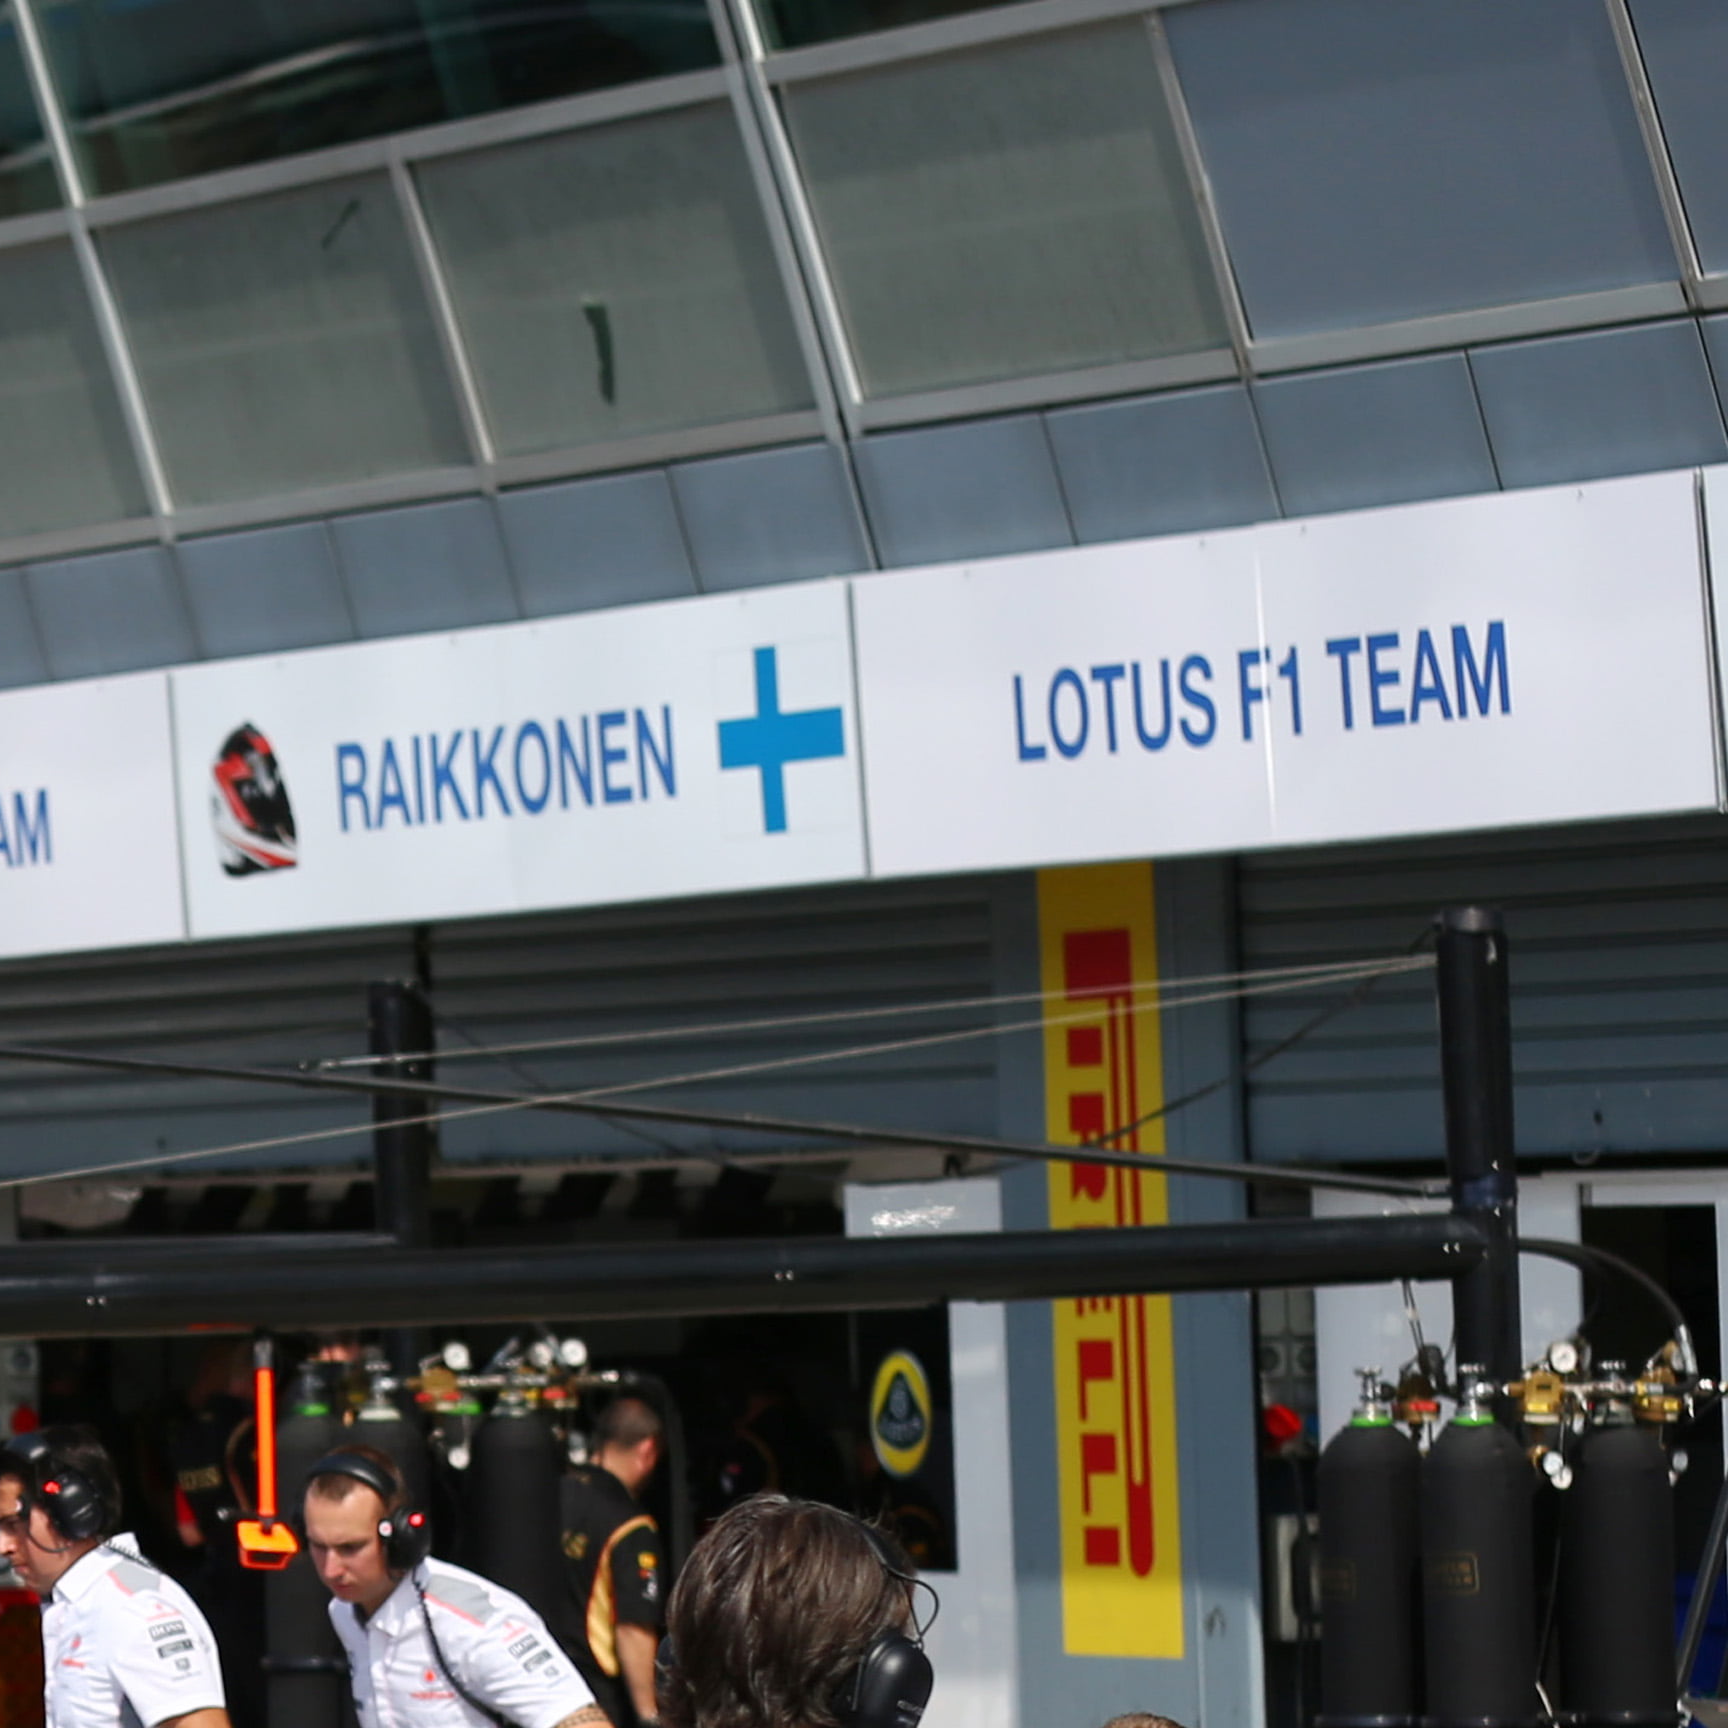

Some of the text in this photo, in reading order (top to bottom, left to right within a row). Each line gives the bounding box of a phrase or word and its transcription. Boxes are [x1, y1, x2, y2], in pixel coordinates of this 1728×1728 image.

[1011, 620, 1511, 762] LOTUS F1 TEAM
[335, 705, 677, 834] RAIKKONEN
[1063, 928, 1154, 1580] PIRLLI
